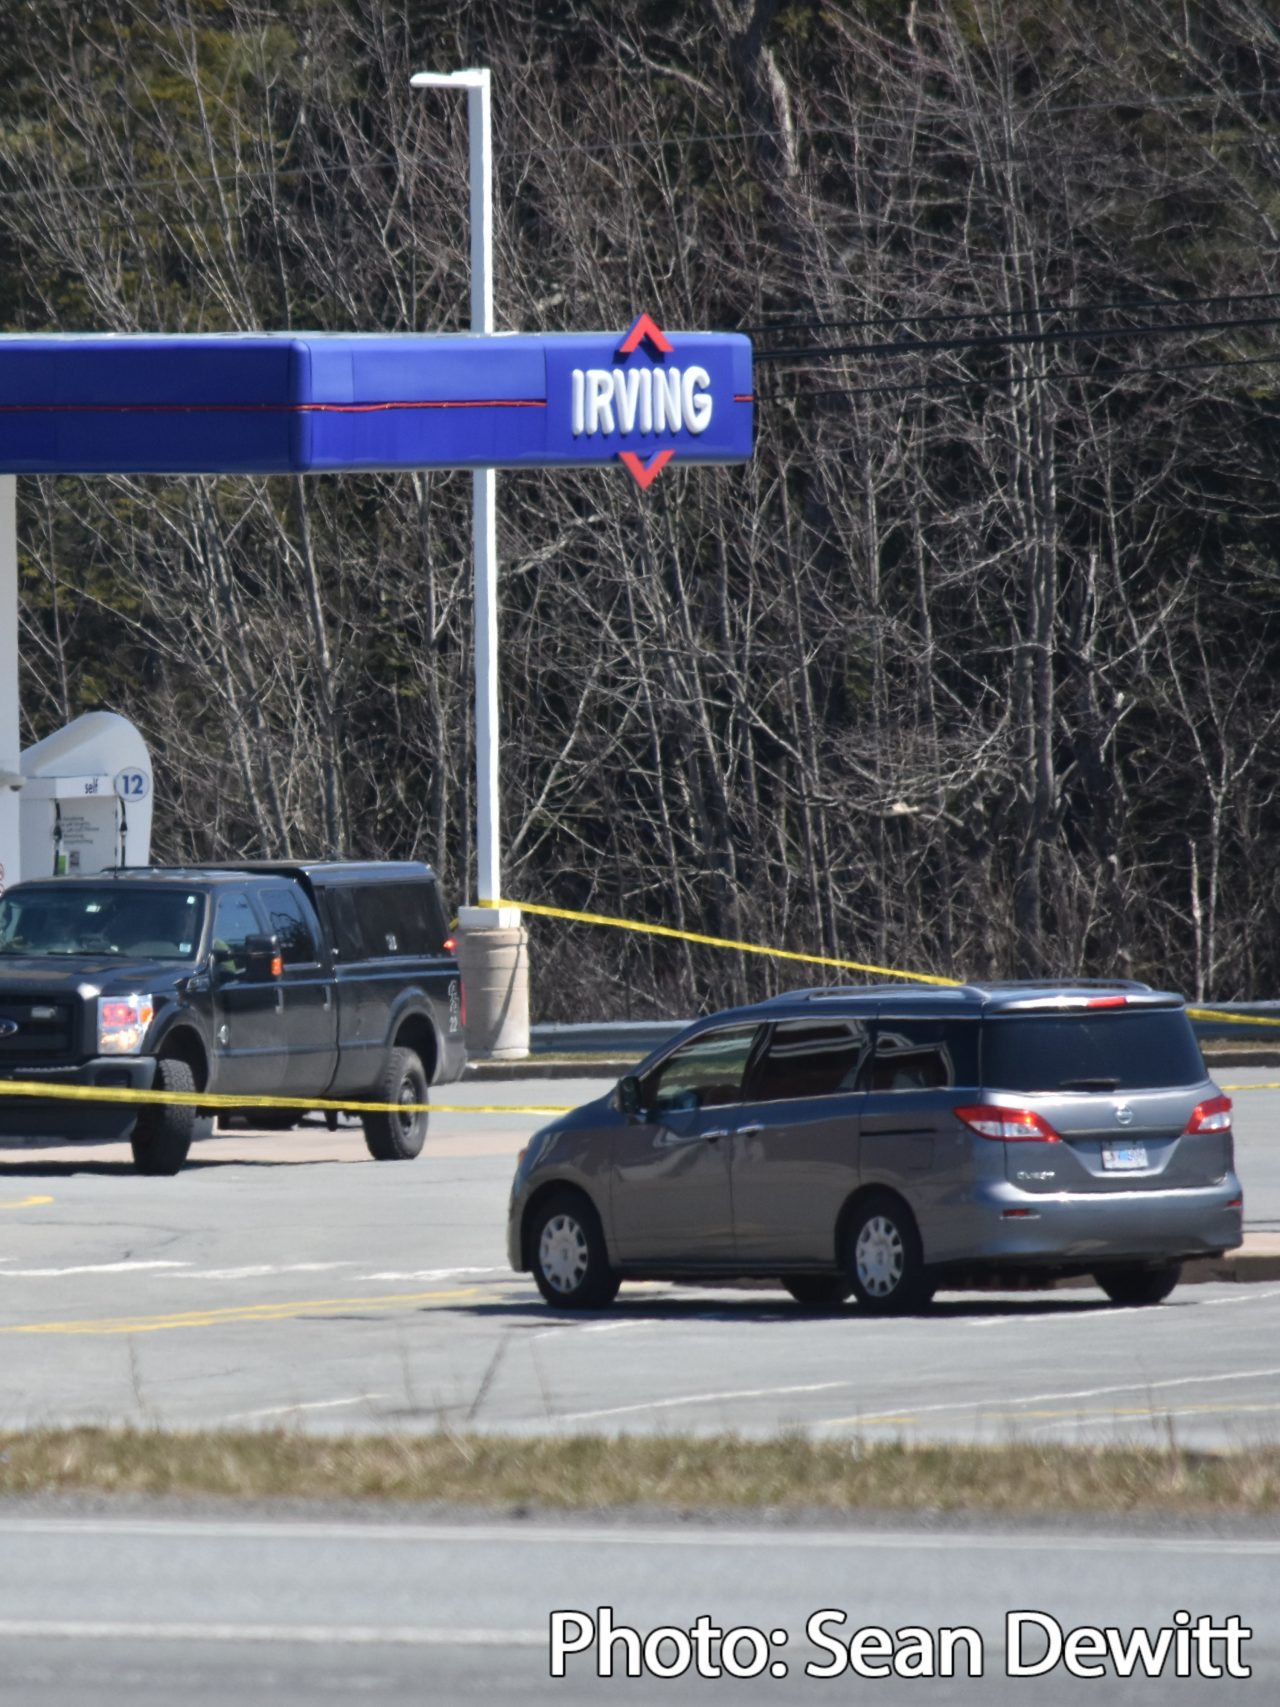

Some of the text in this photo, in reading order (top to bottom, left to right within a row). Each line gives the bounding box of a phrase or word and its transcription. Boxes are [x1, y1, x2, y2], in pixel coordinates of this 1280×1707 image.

[572, 366, 712, 435] IRVING
[84, 776, 98, 794] self
[122, 774, 144, 795] 12
